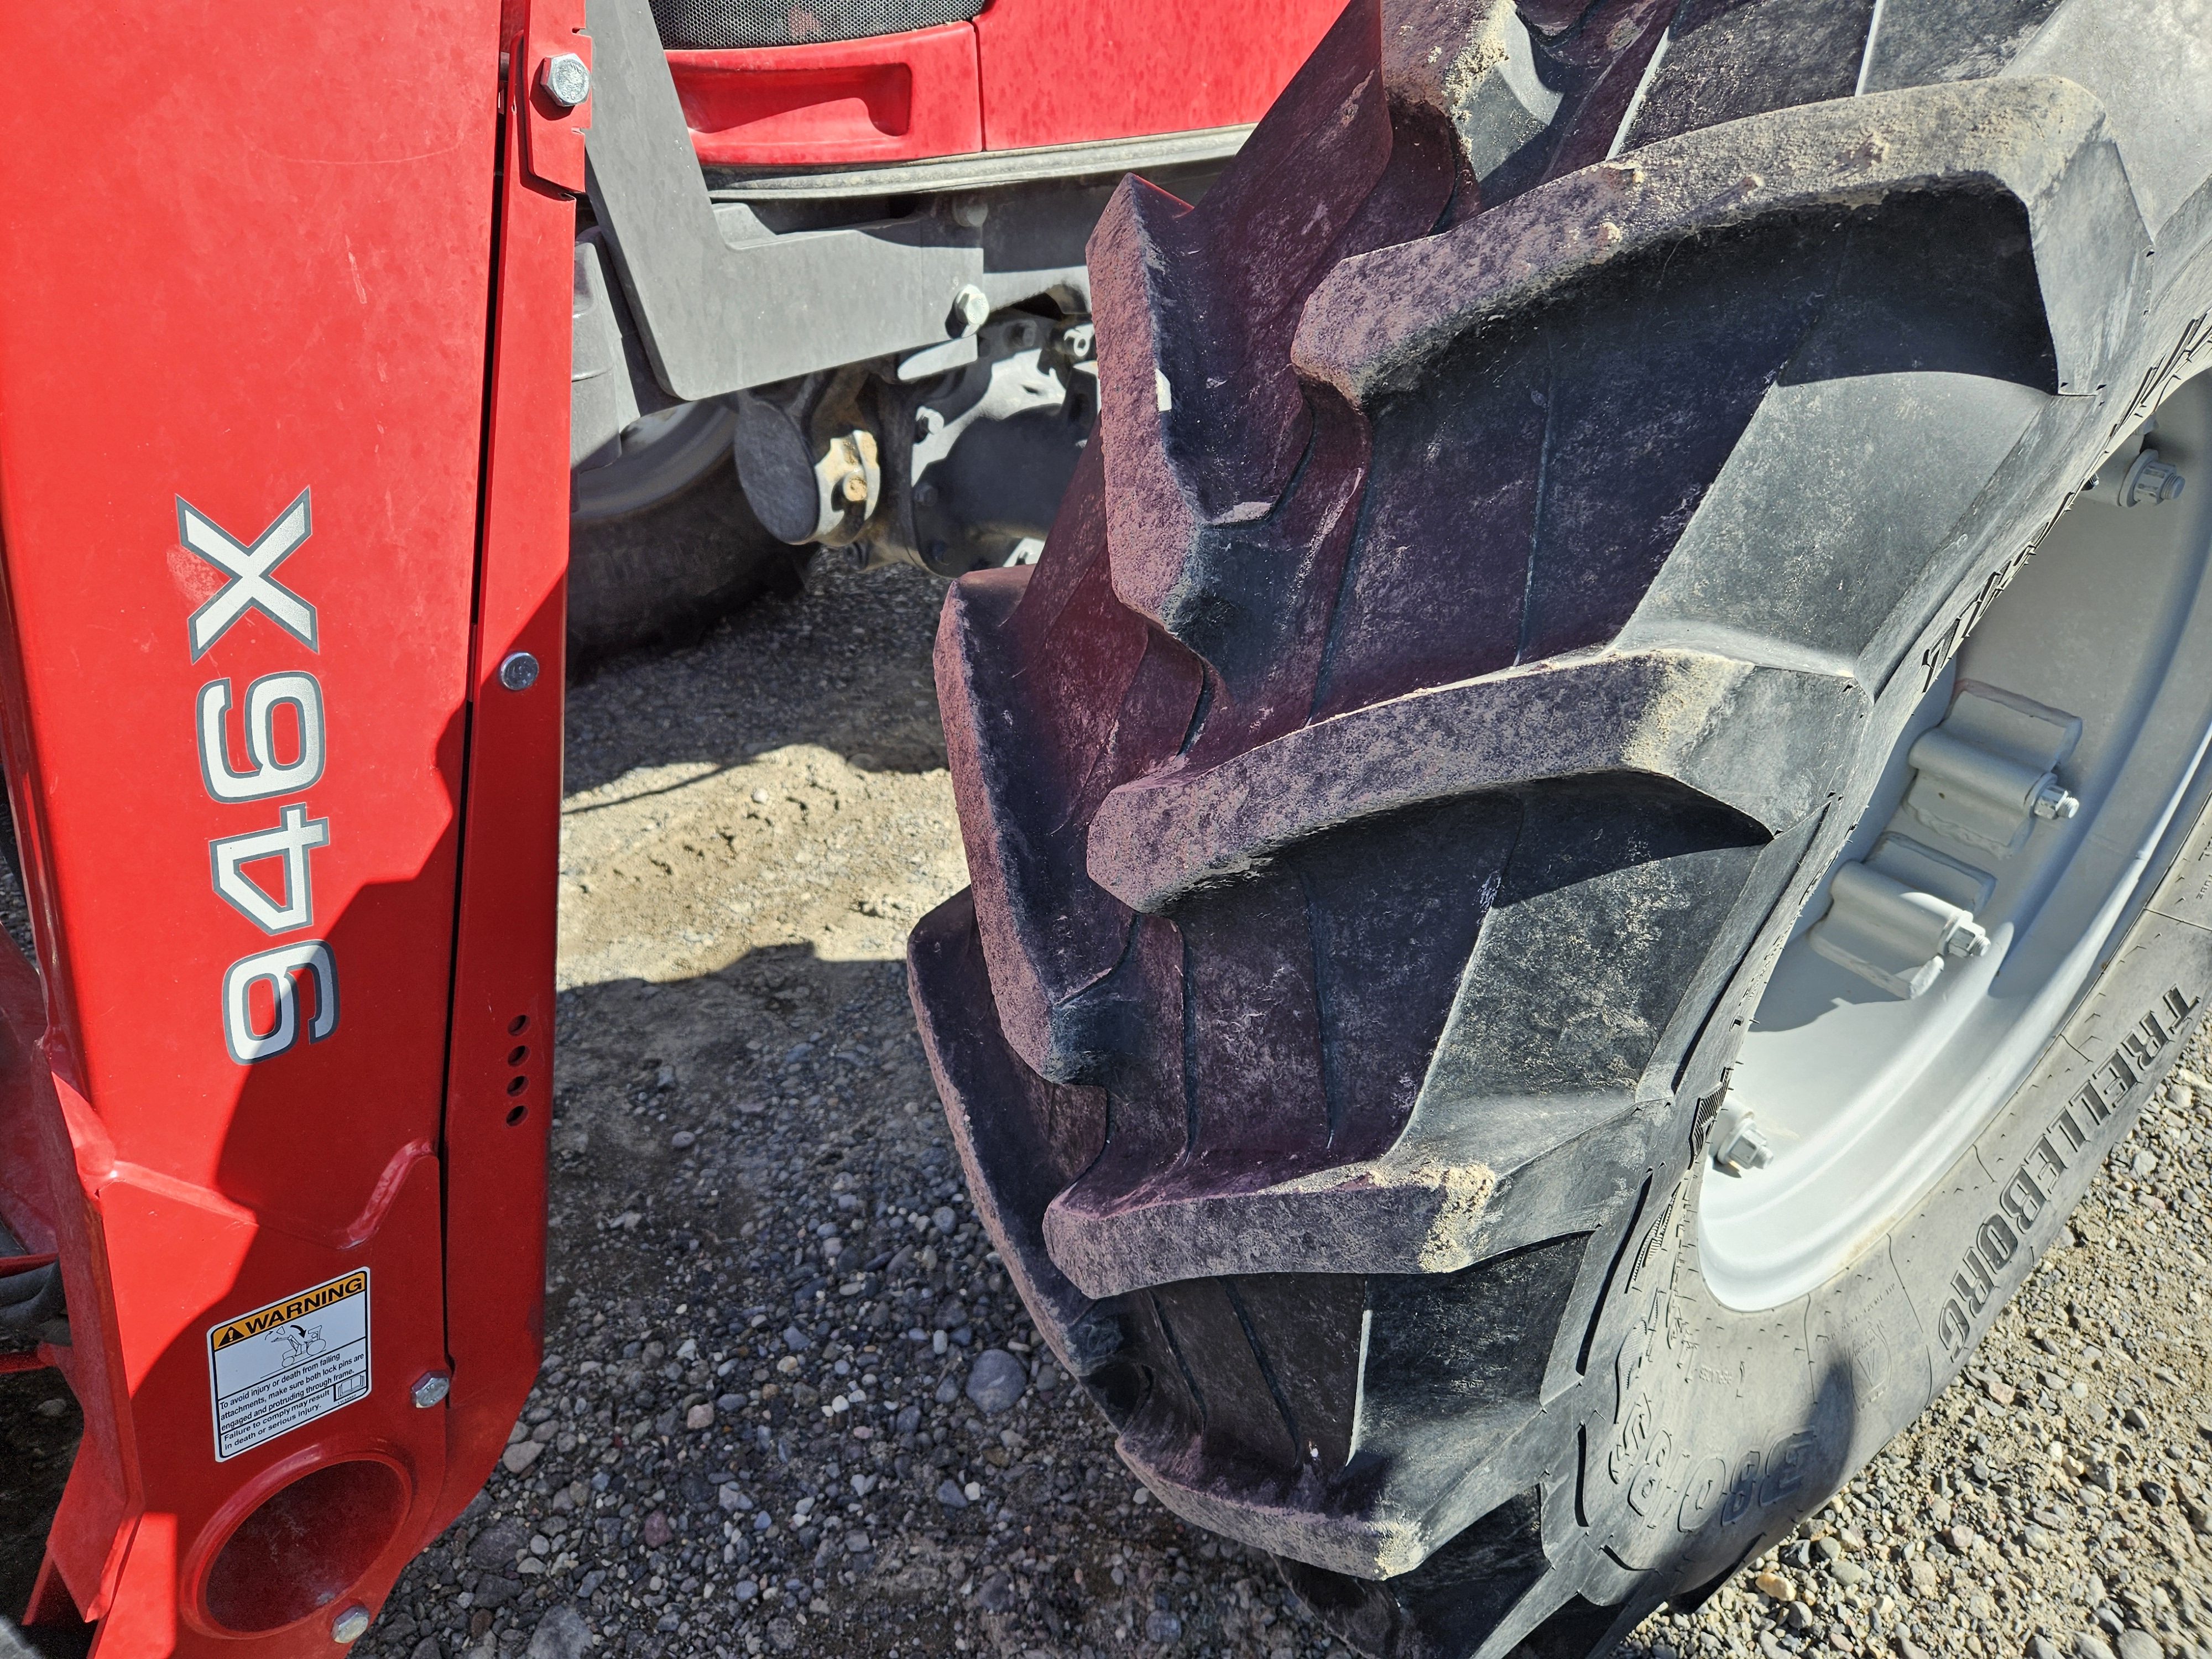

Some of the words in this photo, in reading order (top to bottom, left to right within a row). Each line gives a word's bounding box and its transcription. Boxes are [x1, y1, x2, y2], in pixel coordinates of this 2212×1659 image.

[175, 485, 340, 1065] 946X
[1938, 984, 2201, 1362] TRELLEBORG
[245, 1277, 362, 1334] WARNING
[220, 1401, 228, 1410] To
[230, 1390, 249, 1405] avoid
[251, 1384, 270, 1396] injury
[281, 1370, 300, 1383] death
[302, 1363, 319, 1374] from
[320, 1353, 340, 1366] falling
[221, 1397, 267, 1421] attachments,
[269, 1386, 288, 1400] make
[289, 1379, 304, 1390] sure
[306, 1371, 321, 1383] both
[322, 1365, 337, 1376] lock
[338, 1359, 352, 1372] pins
[354, 1354, 364, 1362] are
[221, 1413, 252, 1431] engaged
[254, 1406, 267, 1417] and
[269, 1389, 304, 1412] protruding
[306, 1378, 332, 1396] through
[333, 1369, 354, 1383] frame.
[224, 1425, 251, 1441] Failure
[263, 1408, 291, 1425] comply
[291, 1400, 308, 1412] may
[310, 1390, 330, 1404] result
[234, 1431, 255, 1446] death
[268, 1413, 296, 1431] serious
[298, 1404, 321, 1418] injury.
